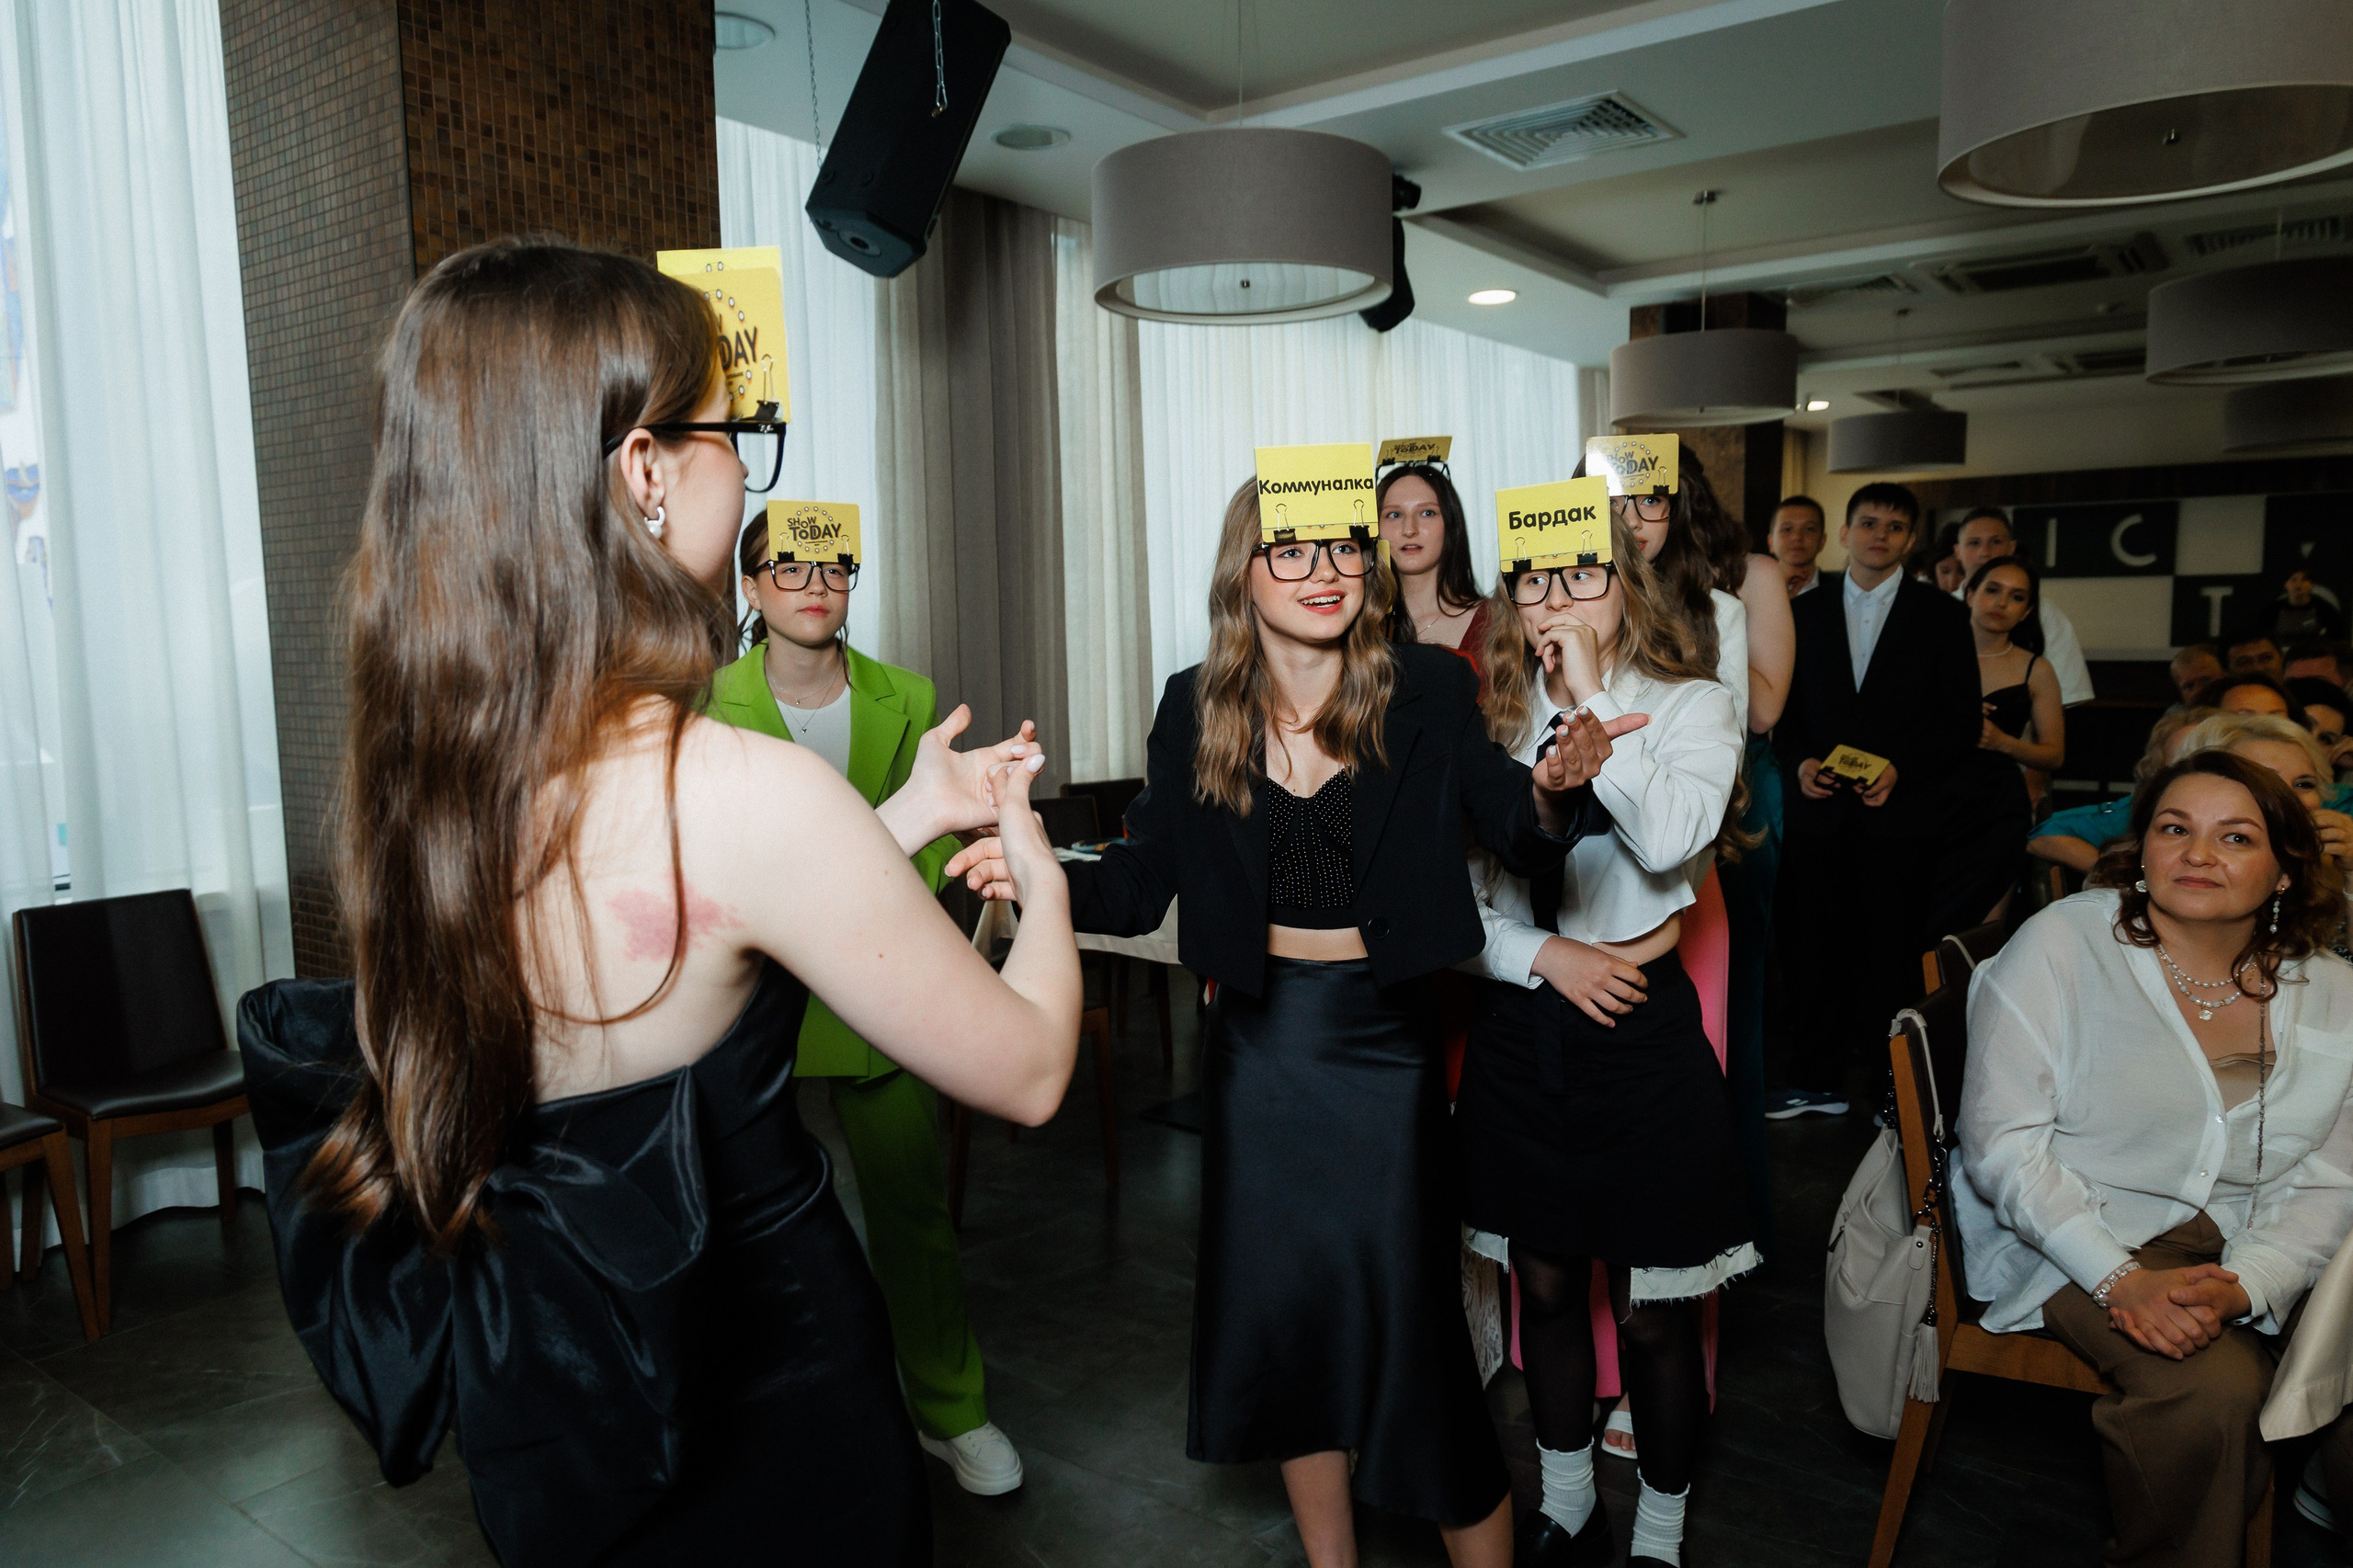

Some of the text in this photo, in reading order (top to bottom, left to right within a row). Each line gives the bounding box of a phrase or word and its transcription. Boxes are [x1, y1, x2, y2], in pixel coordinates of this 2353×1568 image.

[717, 326, 758, 371] DAY
[1258, 478, 1374, 495] Коммуналка
[1508, 506, 1597, 531] Бардак
